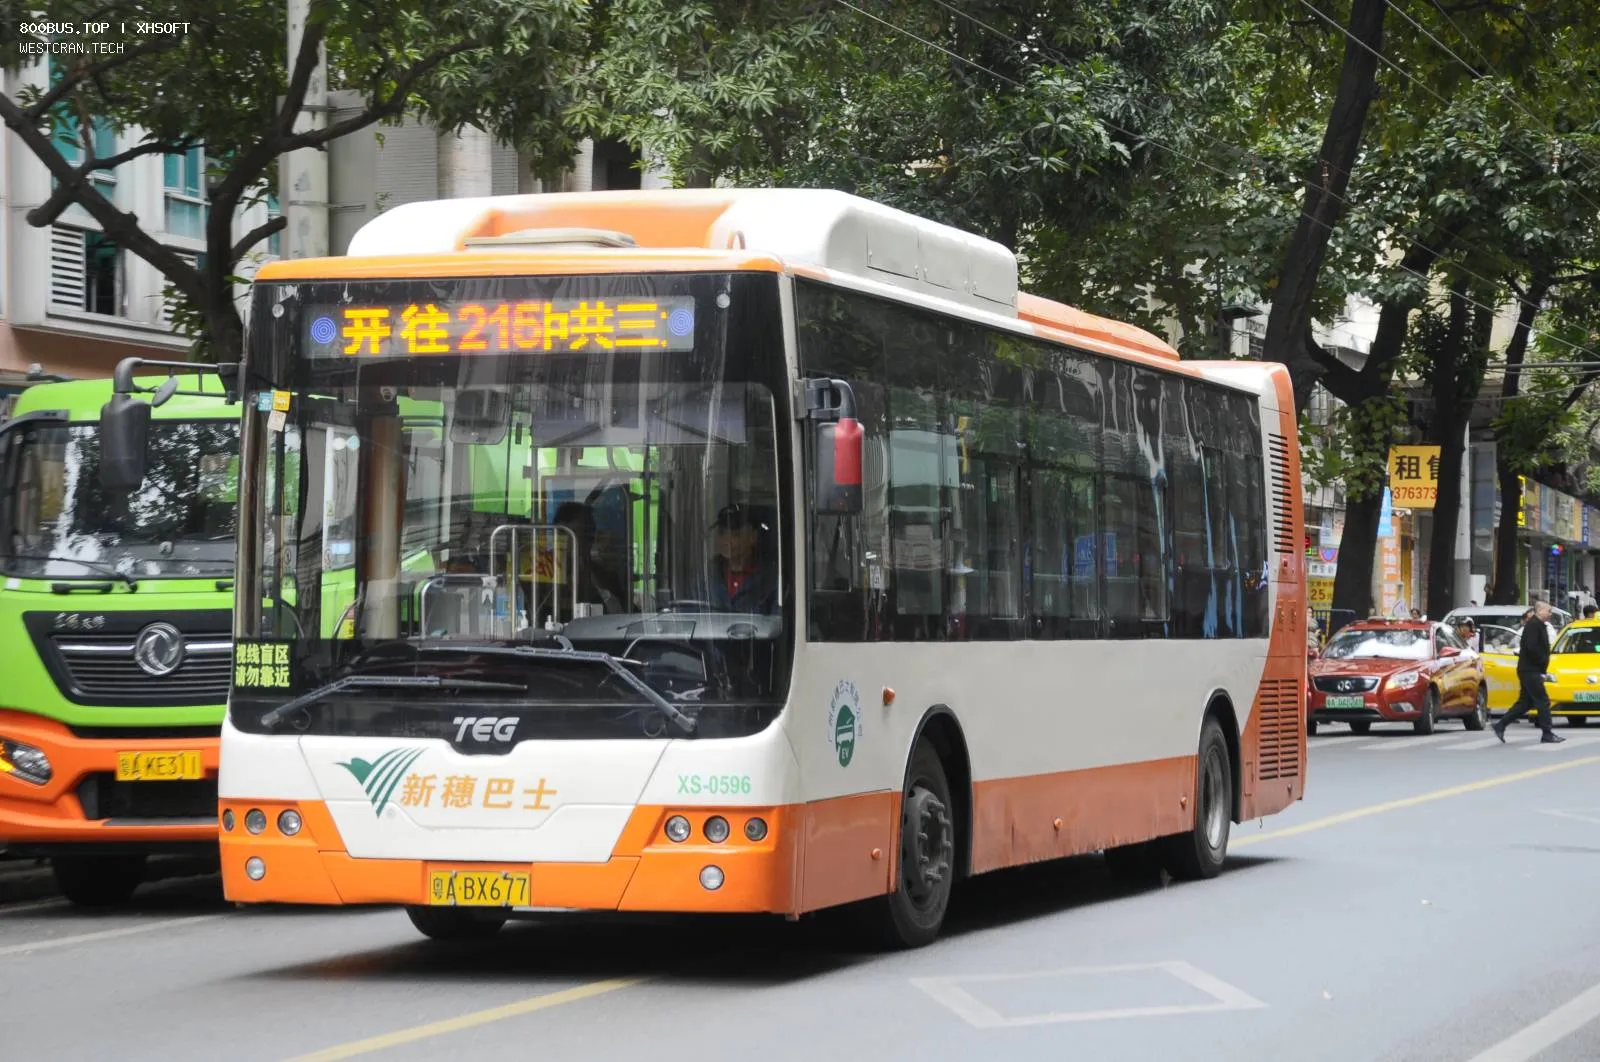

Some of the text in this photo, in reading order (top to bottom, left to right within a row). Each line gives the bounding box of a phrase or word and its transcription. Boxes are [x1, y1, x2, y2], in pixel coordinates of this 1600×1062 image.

[343, 303, 450, 355] 开往
[543, 301, 667, 350] 中共三
[452, 716, 520, 742] TEG
[400, 773, 558, 810] 新穗巴士
[677, 776, 751, 795] XS-0596
